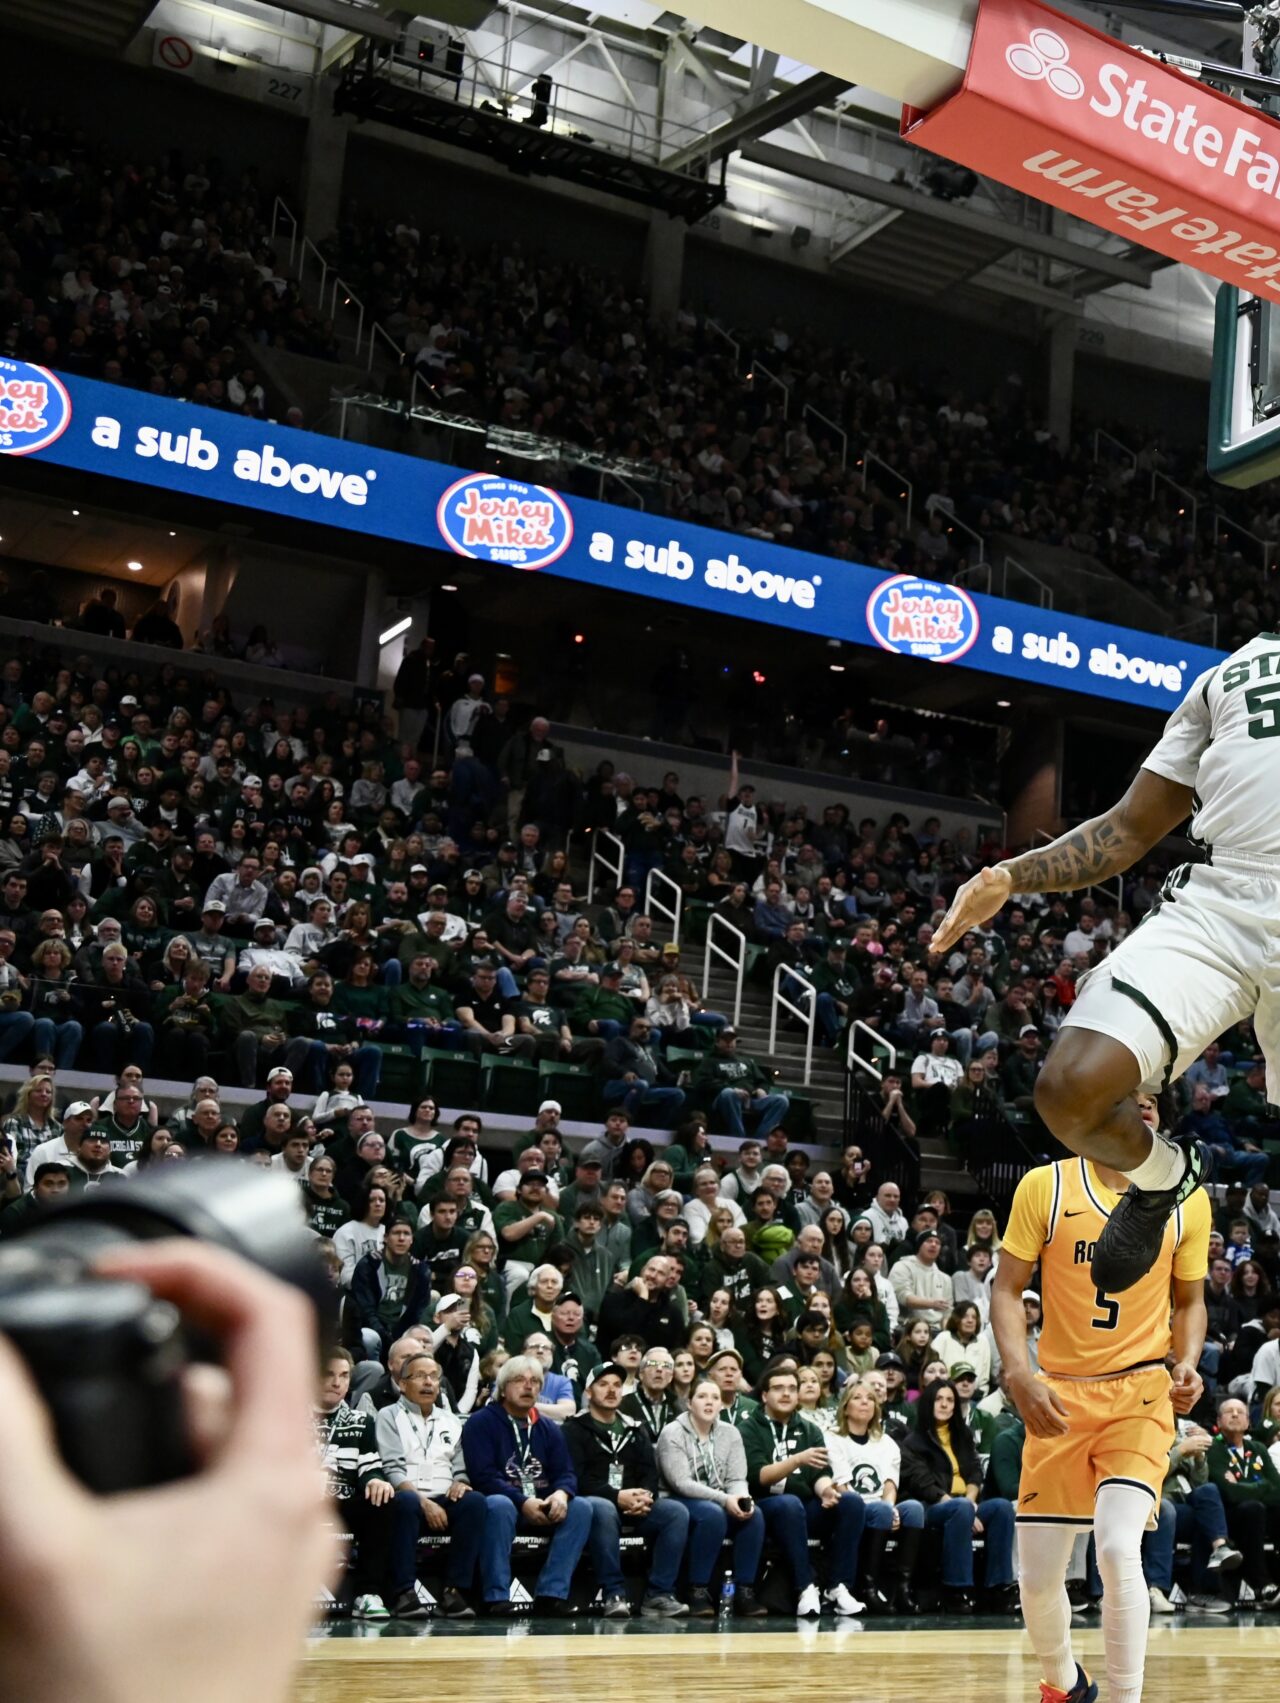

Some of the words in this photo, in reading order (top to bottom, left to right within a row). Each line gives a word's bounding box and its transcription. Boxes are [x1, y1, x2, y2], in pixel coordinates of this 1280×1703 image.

[268, 78, 303, 101] 227
[91, 416, 121, 450] a
[135, 426, 219, 471] sub
[457, 490, 553, 527] Jersey
[490, 548, 527, 561] SUBS
[589, 532, 613, 562] a
[625, 540, 694, 580] sub
[883, 589, 963, 623] Jersey
[992, 626, 1013, 654] a
[1021, 632, 1080, 668] sub
[1091, 1287, 1119, 1330] 5
